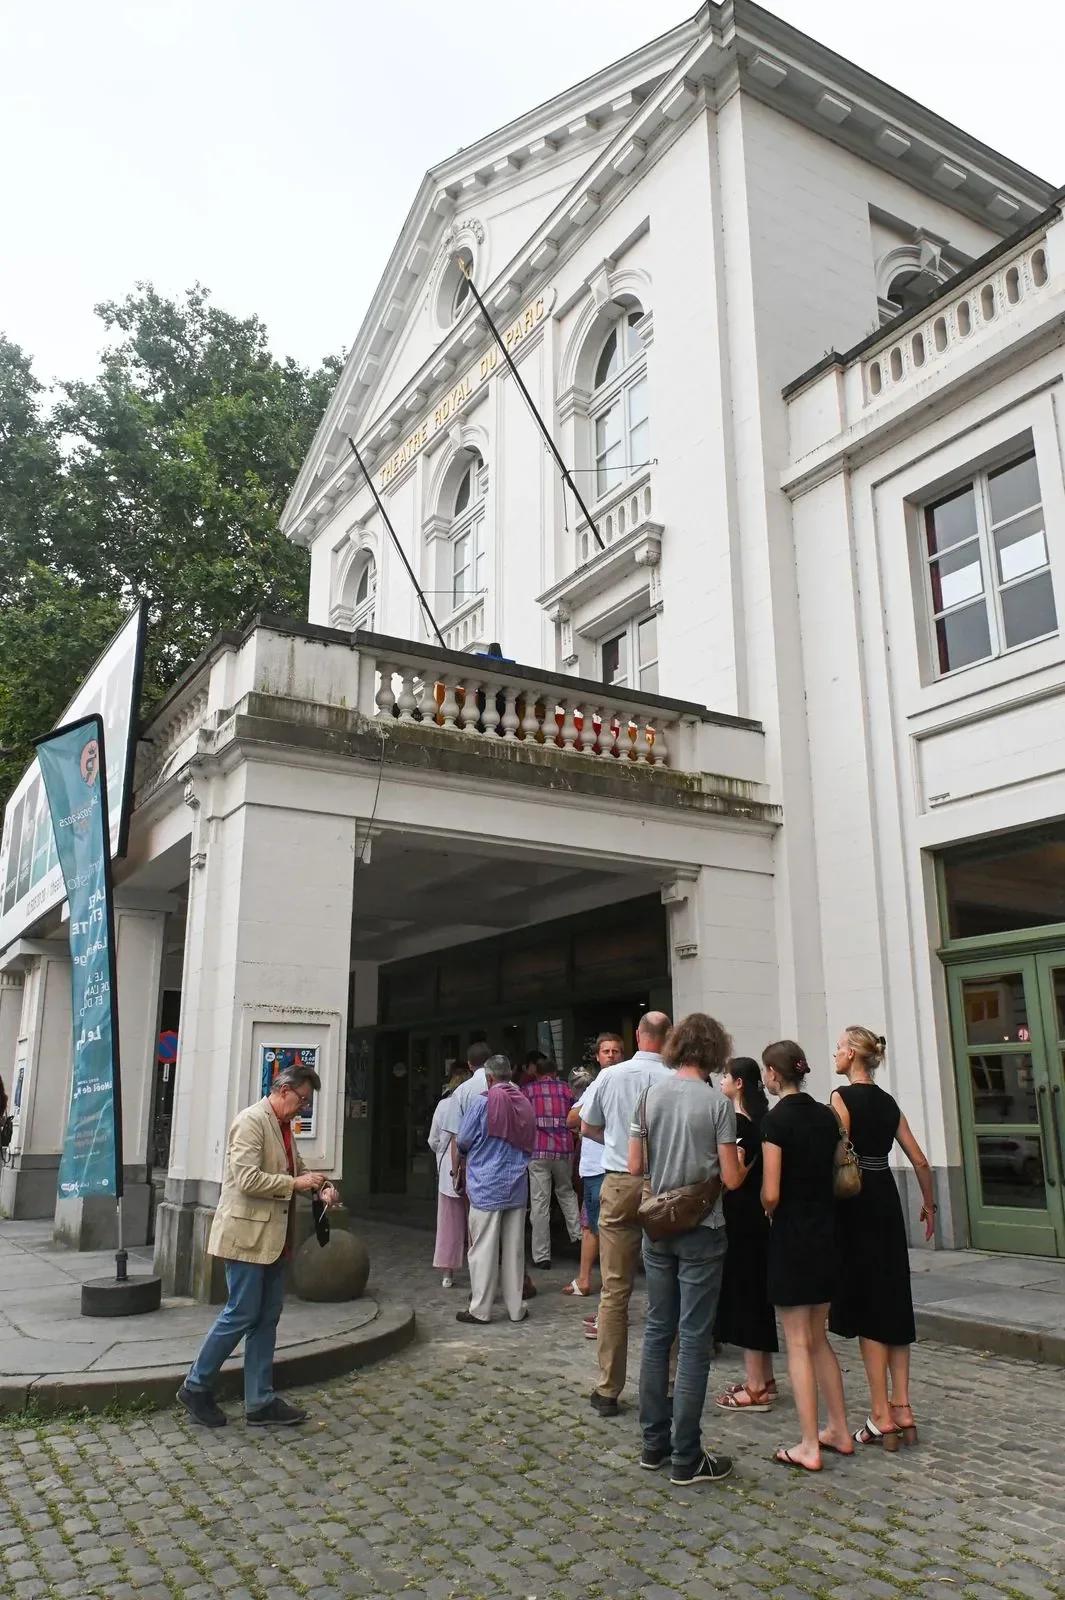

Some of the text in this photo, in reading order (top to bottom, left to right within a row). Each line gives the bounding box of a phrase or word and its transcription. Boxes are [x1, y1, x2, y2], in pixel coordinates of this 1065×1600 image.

[434, 376, 473, 430] ROYAL
[479, 347, 498, 382] DU
[505, 297, 545, 353] PARC
